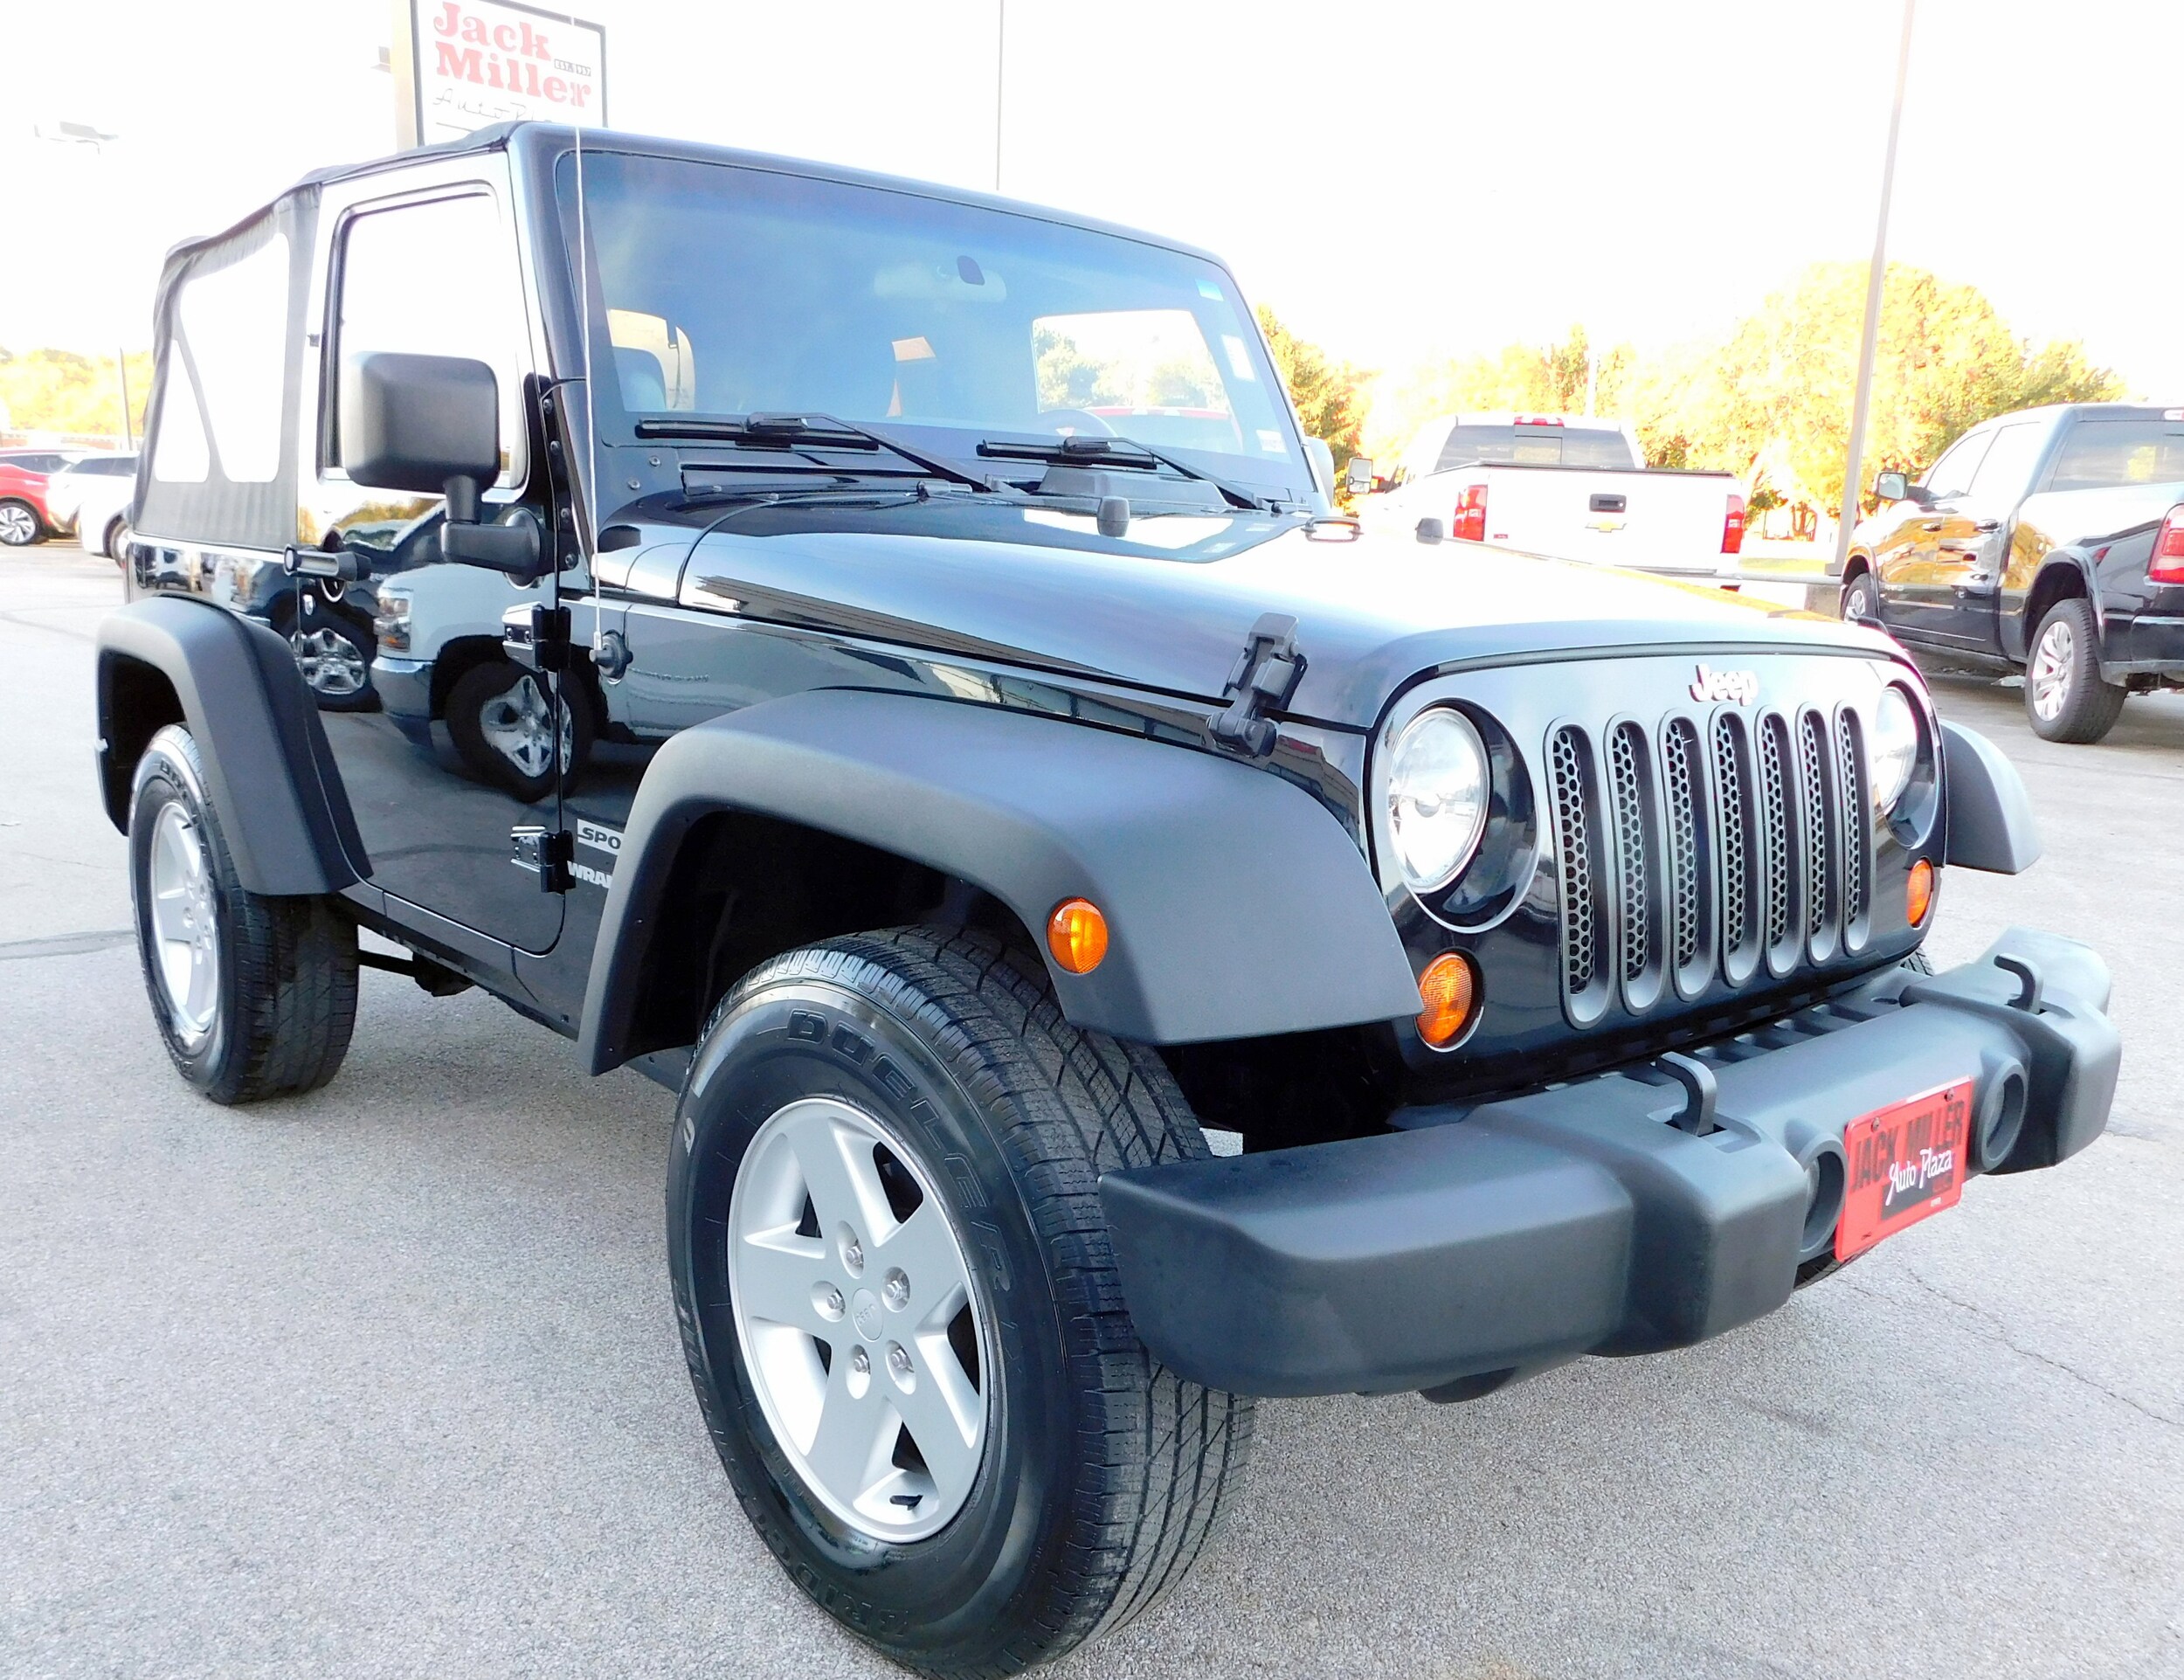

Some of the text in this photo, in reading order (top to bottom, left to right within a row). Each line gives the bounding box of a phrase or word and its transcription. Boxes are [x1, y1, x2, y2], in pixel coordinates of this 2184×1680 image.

[433, 2, 551, 61] Jack
[435, 42, 591, 107] Miller
[1689, 663, 1759, 707] Jeep
[1852, 1126, 1899, 1193] JACK
[1885, 1148, 1953, 1206] Auto Plaza
